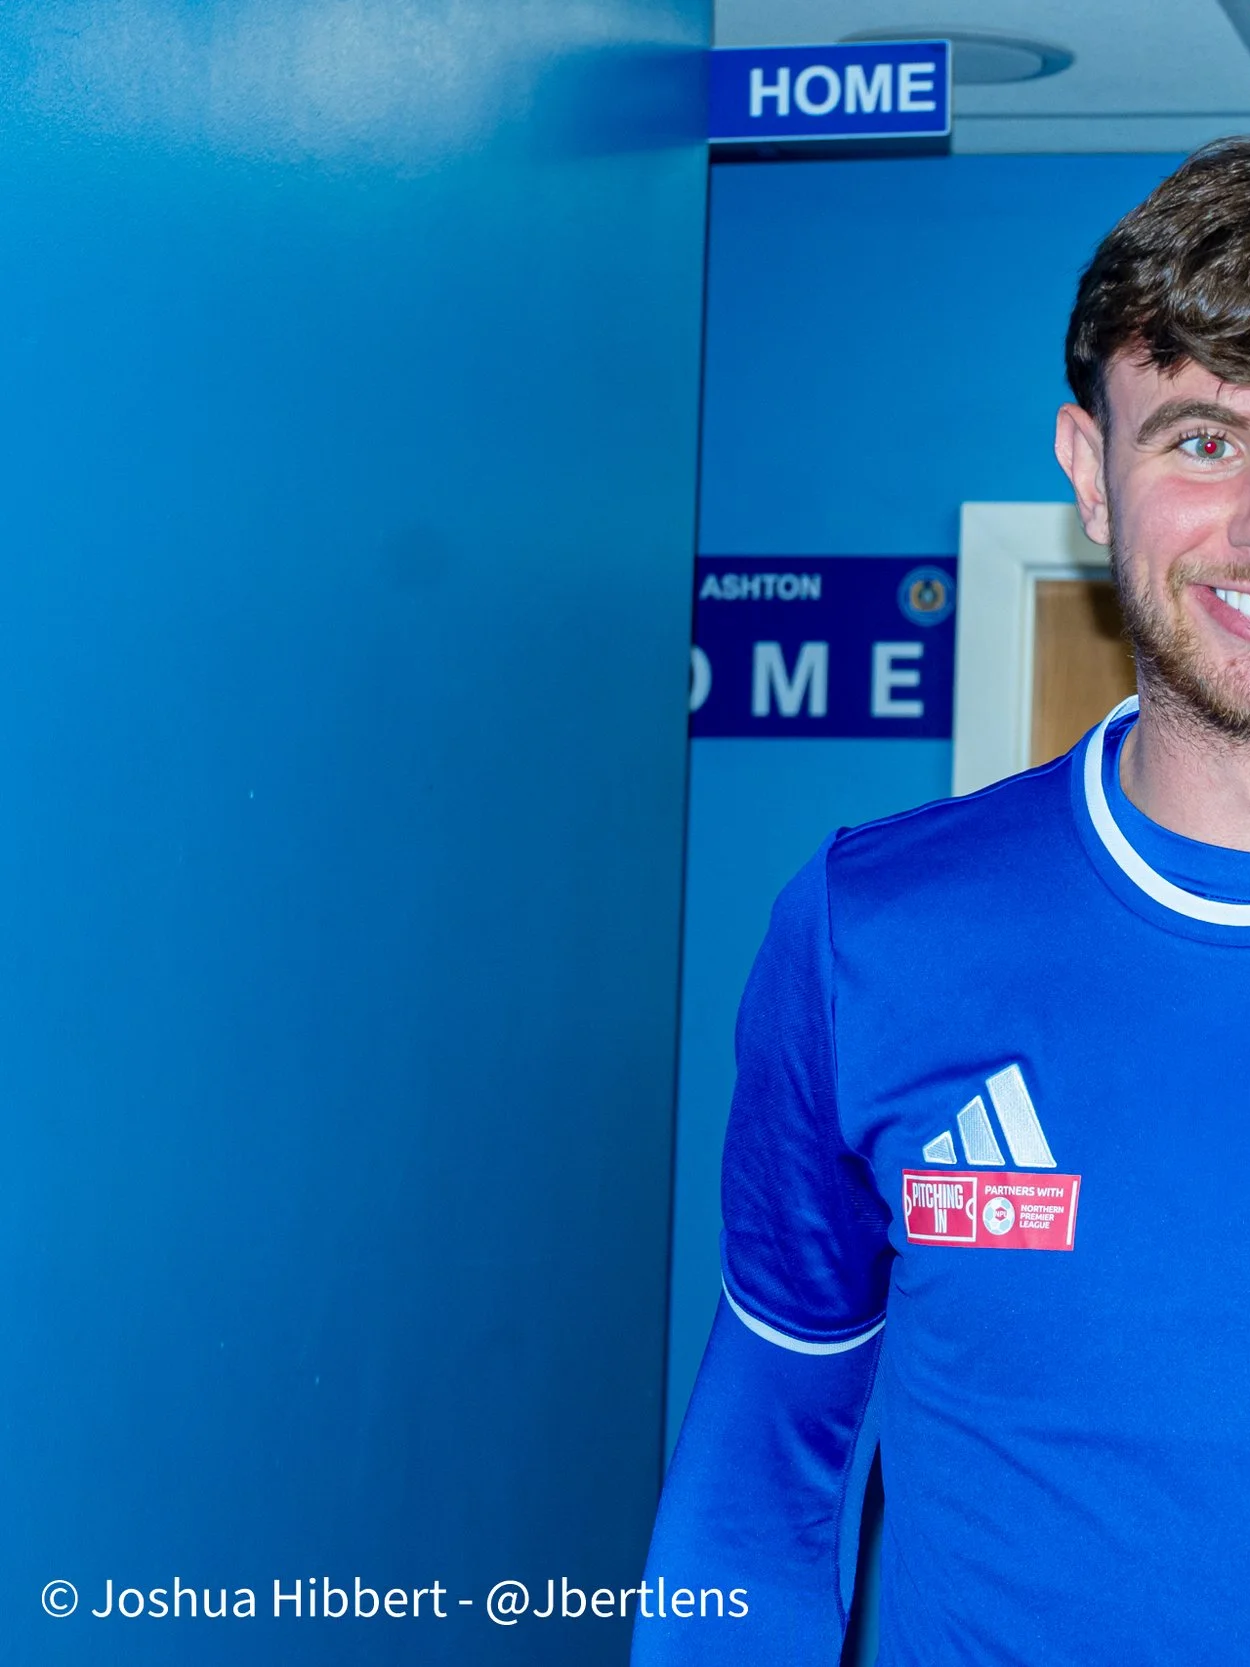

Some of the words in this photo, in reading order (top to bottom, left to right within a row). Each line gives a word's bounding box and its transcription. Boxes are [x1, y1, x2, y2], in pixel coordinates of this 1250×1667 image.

[750, 62, 936, 117] HOME
[700, 573, 822, 600] ASHTON
[690, 640, 924, 718] ME
[912, 1182, 964, 1210] PITCHING
[984, 1185, 1035, 1197] PARTNERS
[1036, 1187, 1064, 1198] WITH
[935, 1208, 947, 1234] IN
[1020, 1204, 1064, 1213] NORTHERN
[1020, 1212, 1055, 1221] PREMIER
[1019, 1220, 1051, 1229] LEAGUE
